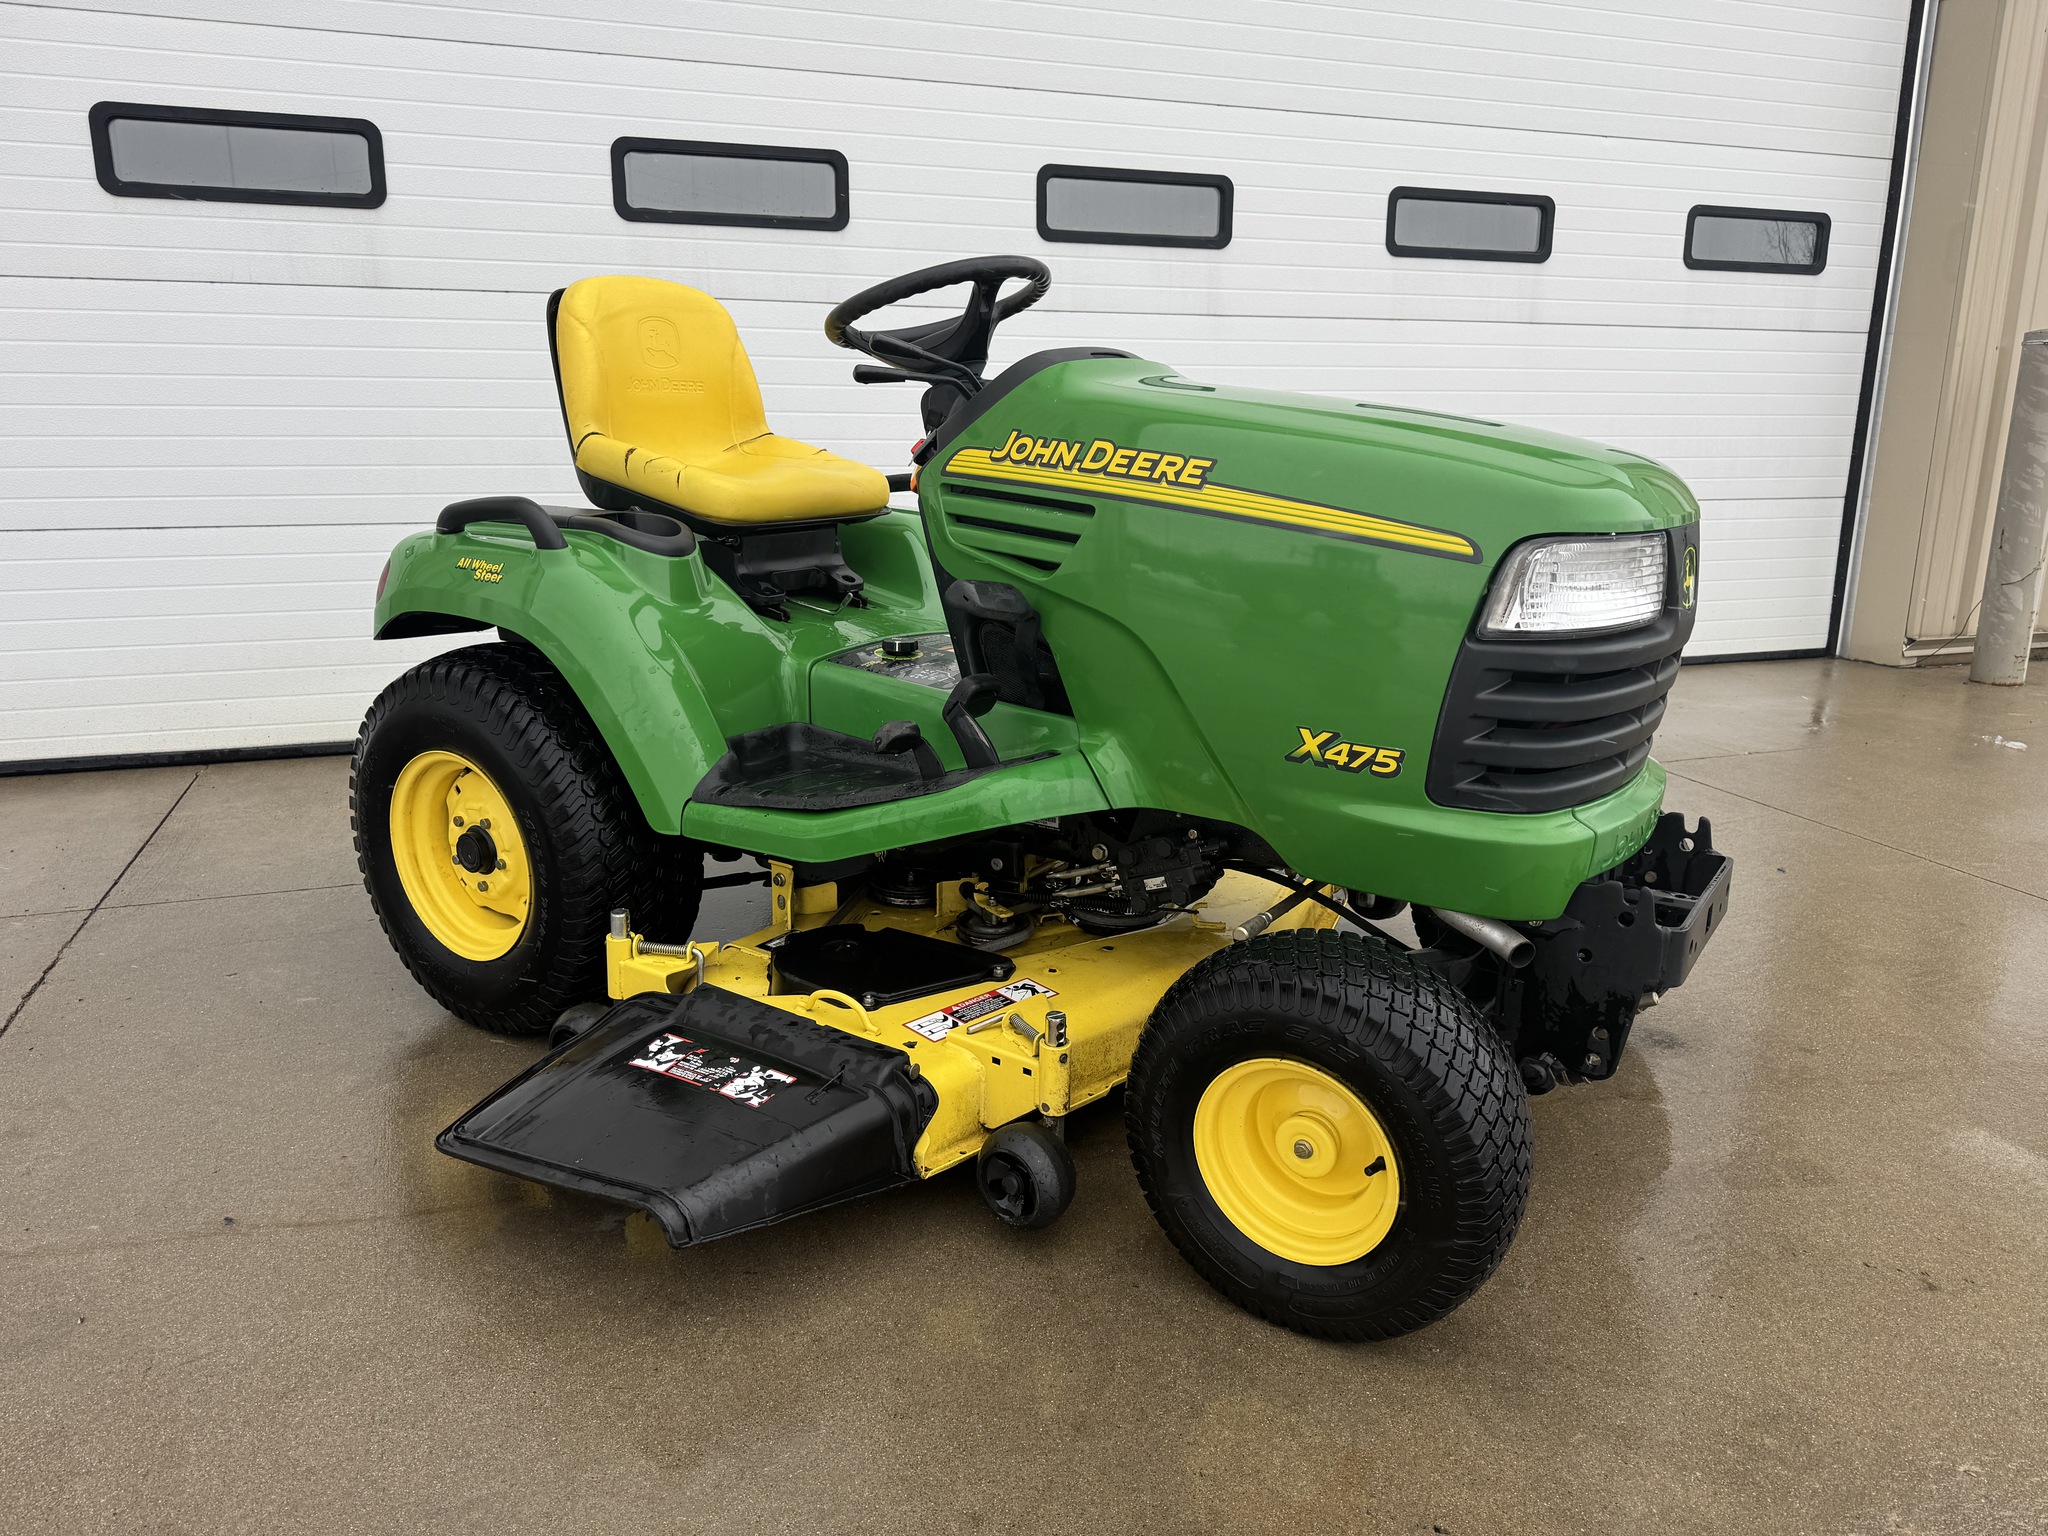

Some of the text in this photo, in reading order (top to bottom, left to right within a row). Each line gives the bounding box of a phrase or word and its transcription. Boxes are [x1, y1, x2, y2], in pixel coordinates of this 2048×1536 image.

[626, 377, 705, 394] JOHN DEERE
[990, 428, 1216, 490] JOHN DEERE
[456, 557, 505, 573] All Wheel
[473, 569, 504, 584] Steer
[1285, 726, 1406, 778] X475
[958, 993, 992, 1007] DANGER
[1149, 1055, 1182, 1158] MULTI
[1182, 1016, 1269, 1058] TRAC
